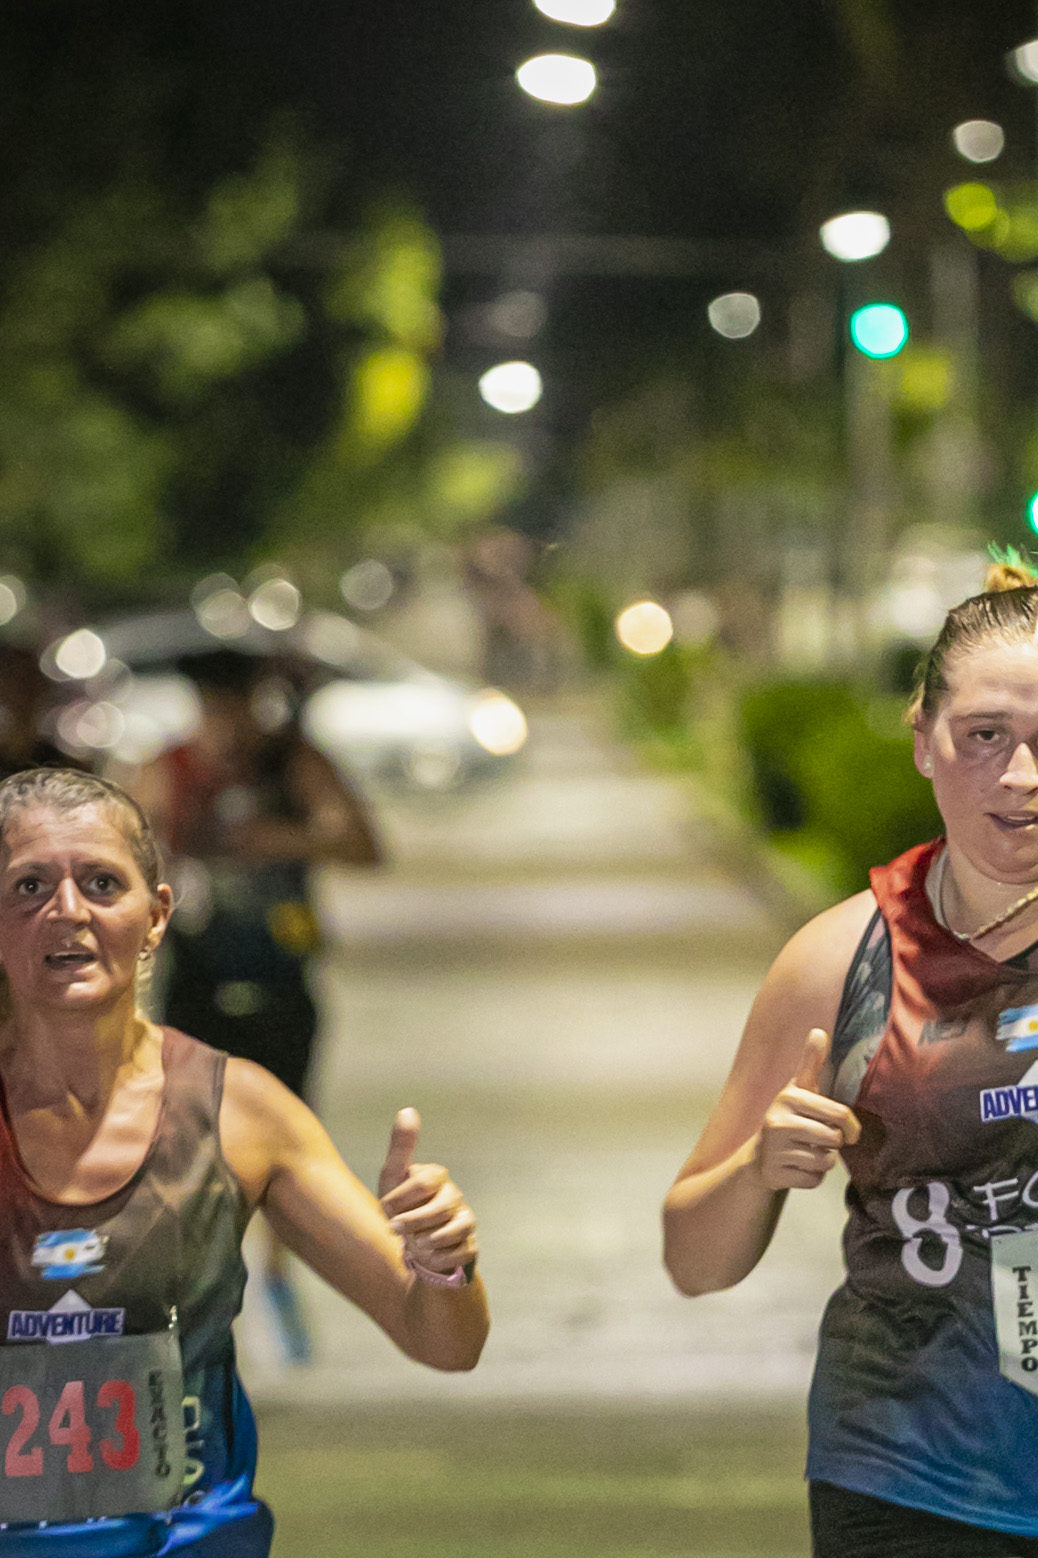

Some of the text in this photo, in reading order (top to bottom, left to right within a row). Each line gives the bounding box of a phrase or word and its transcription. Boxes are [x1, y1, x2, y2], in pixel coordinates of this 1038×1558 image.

[892, 1181, 963, 1287] 8
[11, 1312, 121, 1337] ADVENTURE
[1, 1380, 140, 1478] 243
